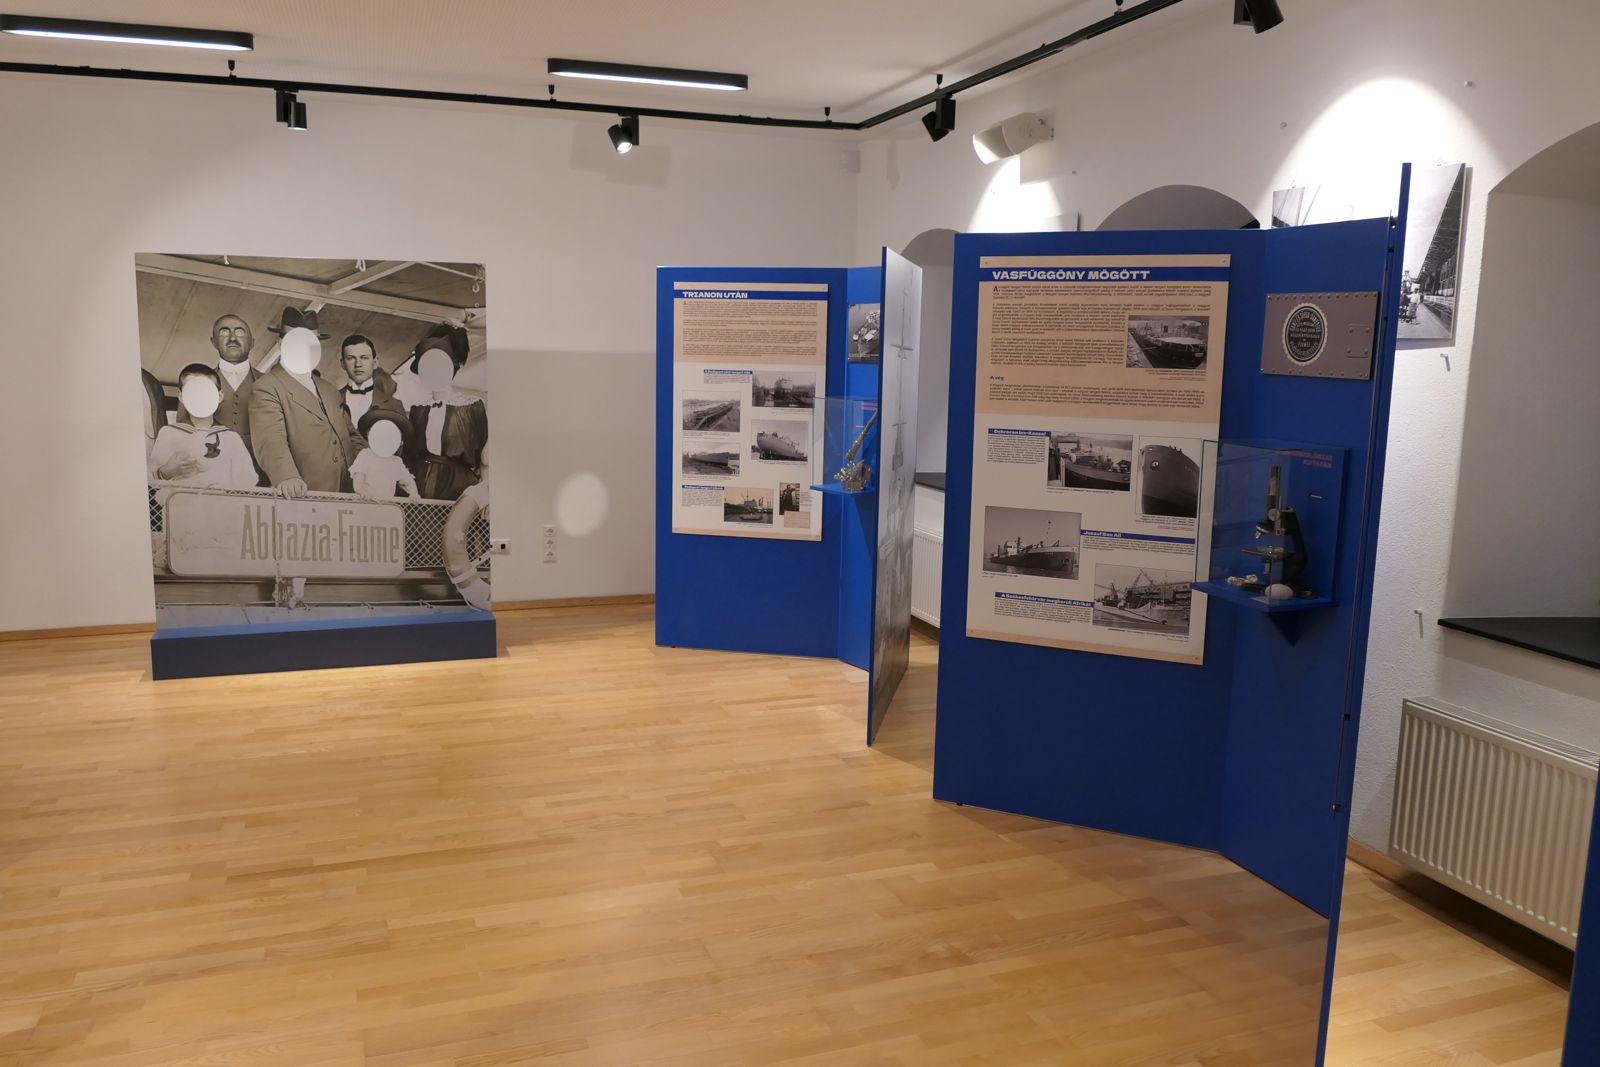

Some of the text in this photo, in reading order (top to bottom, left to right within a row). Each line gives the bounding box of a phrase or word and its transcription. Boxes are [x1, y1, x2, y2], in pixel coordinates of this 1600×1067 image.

[992, 269, 1150, 280] VASFÜGGÖNY MÖGÖTT
[682, 291, 748, 299] TRIANON UTÁN
[240, 504, 399, 563] Abbazia-Fiume
